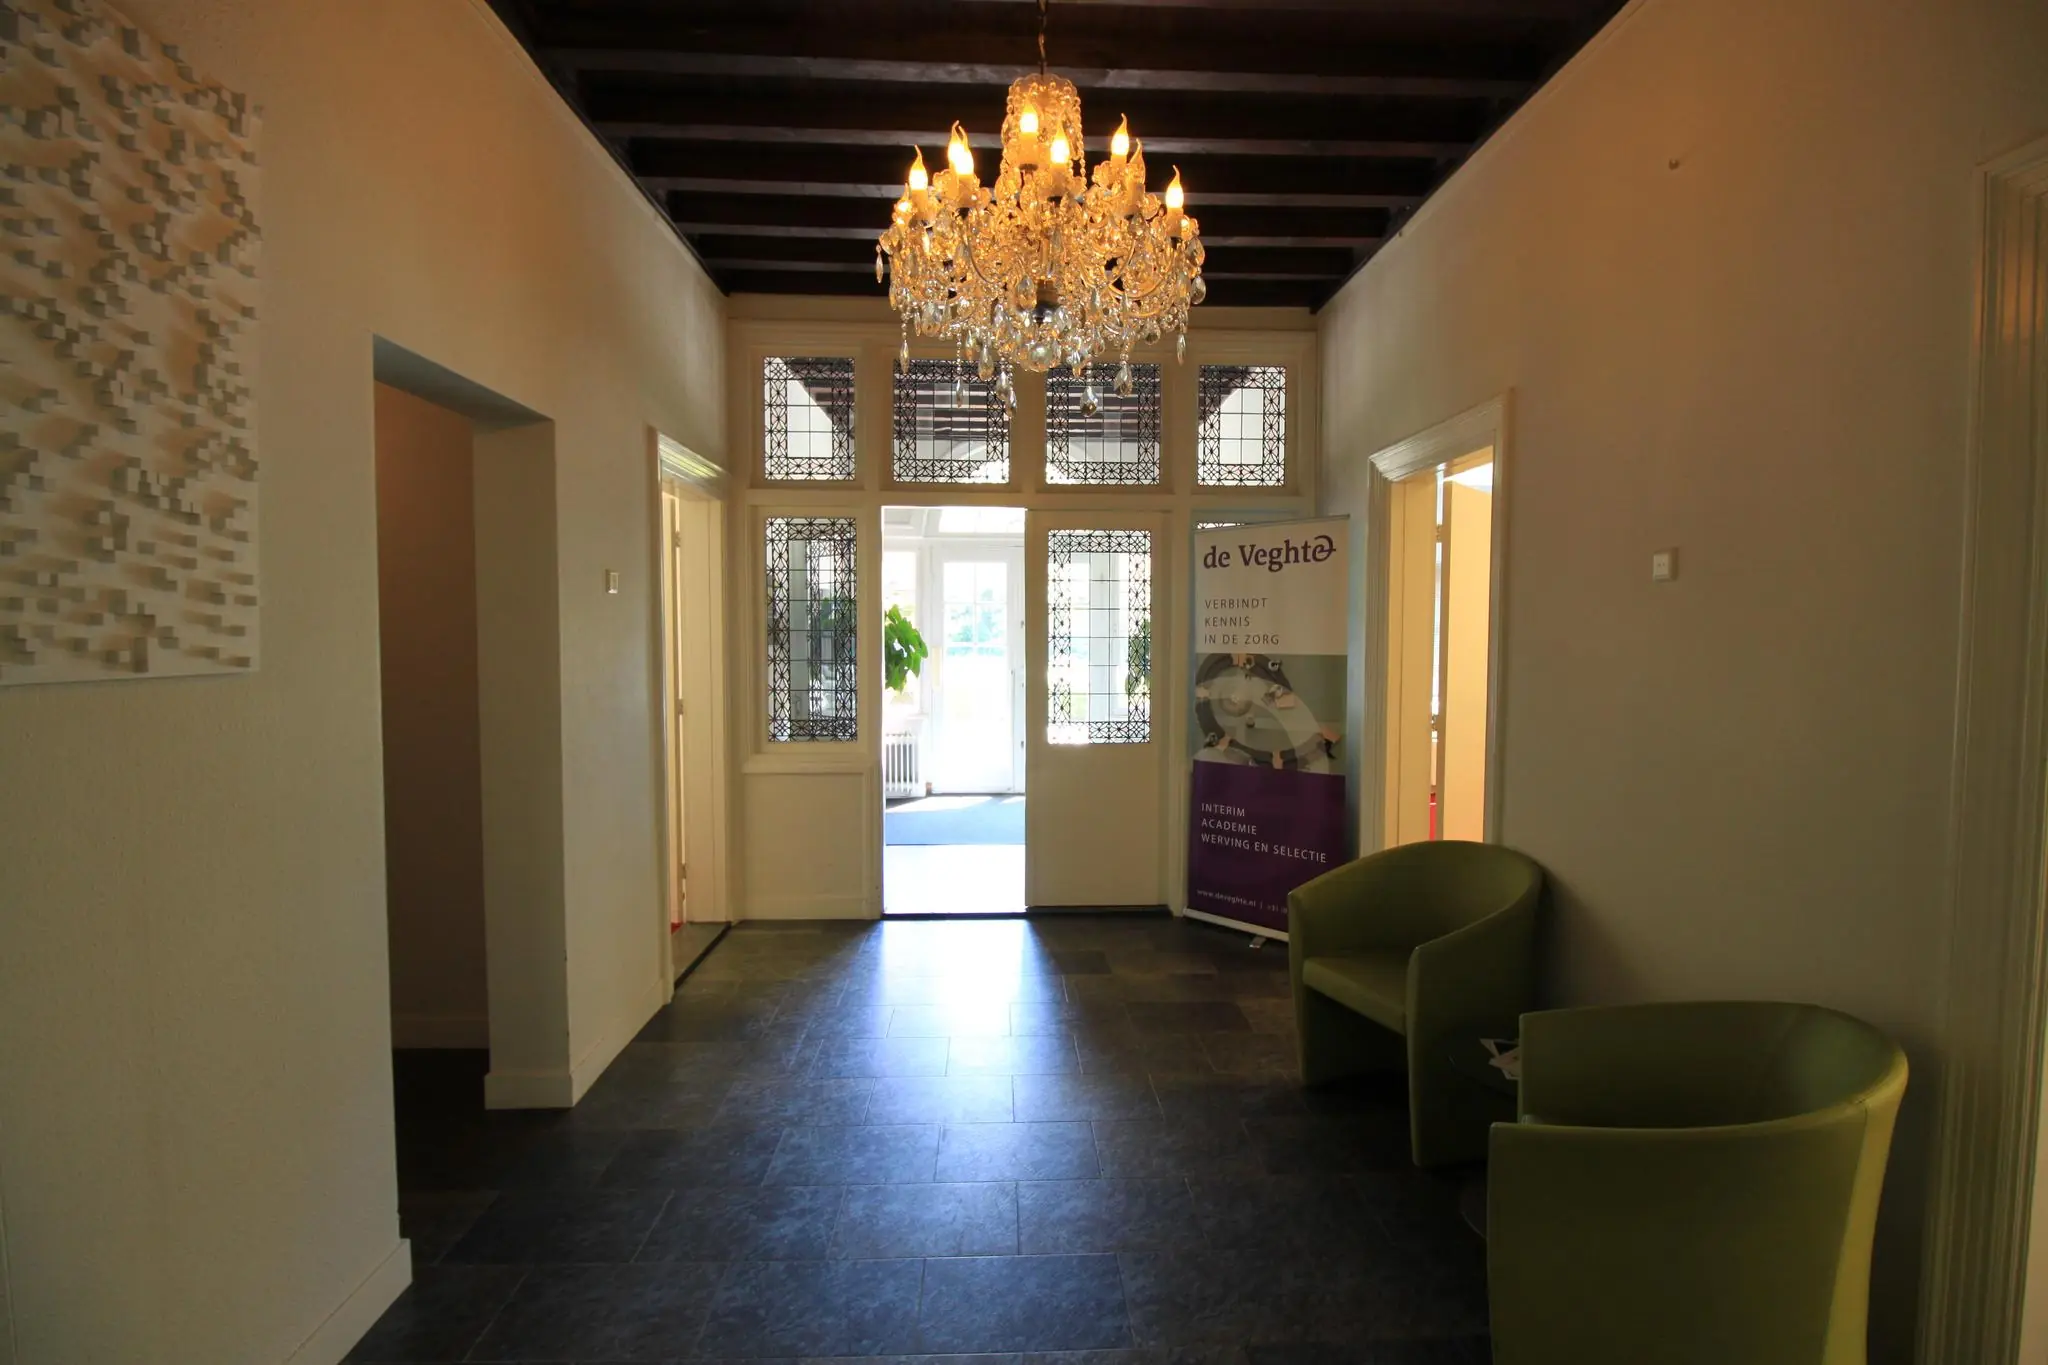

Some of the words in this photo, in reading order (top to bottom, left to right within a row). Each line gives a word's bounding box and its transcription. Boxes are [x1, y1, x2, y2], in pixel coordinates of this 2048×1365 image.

[1203, 545, 1231, 569] de
[1238, 535, 1336, 572] Veghte
[1204, 597, 1268, 610] VERBINDT
[1204, 616, 1251, 628] KENNIS
[1204, 634, 1216, 645] IN
[1222, 634, 1239, 645] DE
[1244, 634, 1280, 646] ZORG
[1201, 803, 1245, 816] INTERIM
[1201, 818, 1257, 835] ACADEMIE
[1201, 834, 1250, 850] WERVING
[1254, 842, 1268, 853] EN
[1273, 845, 1327, 863] SELECTIE
